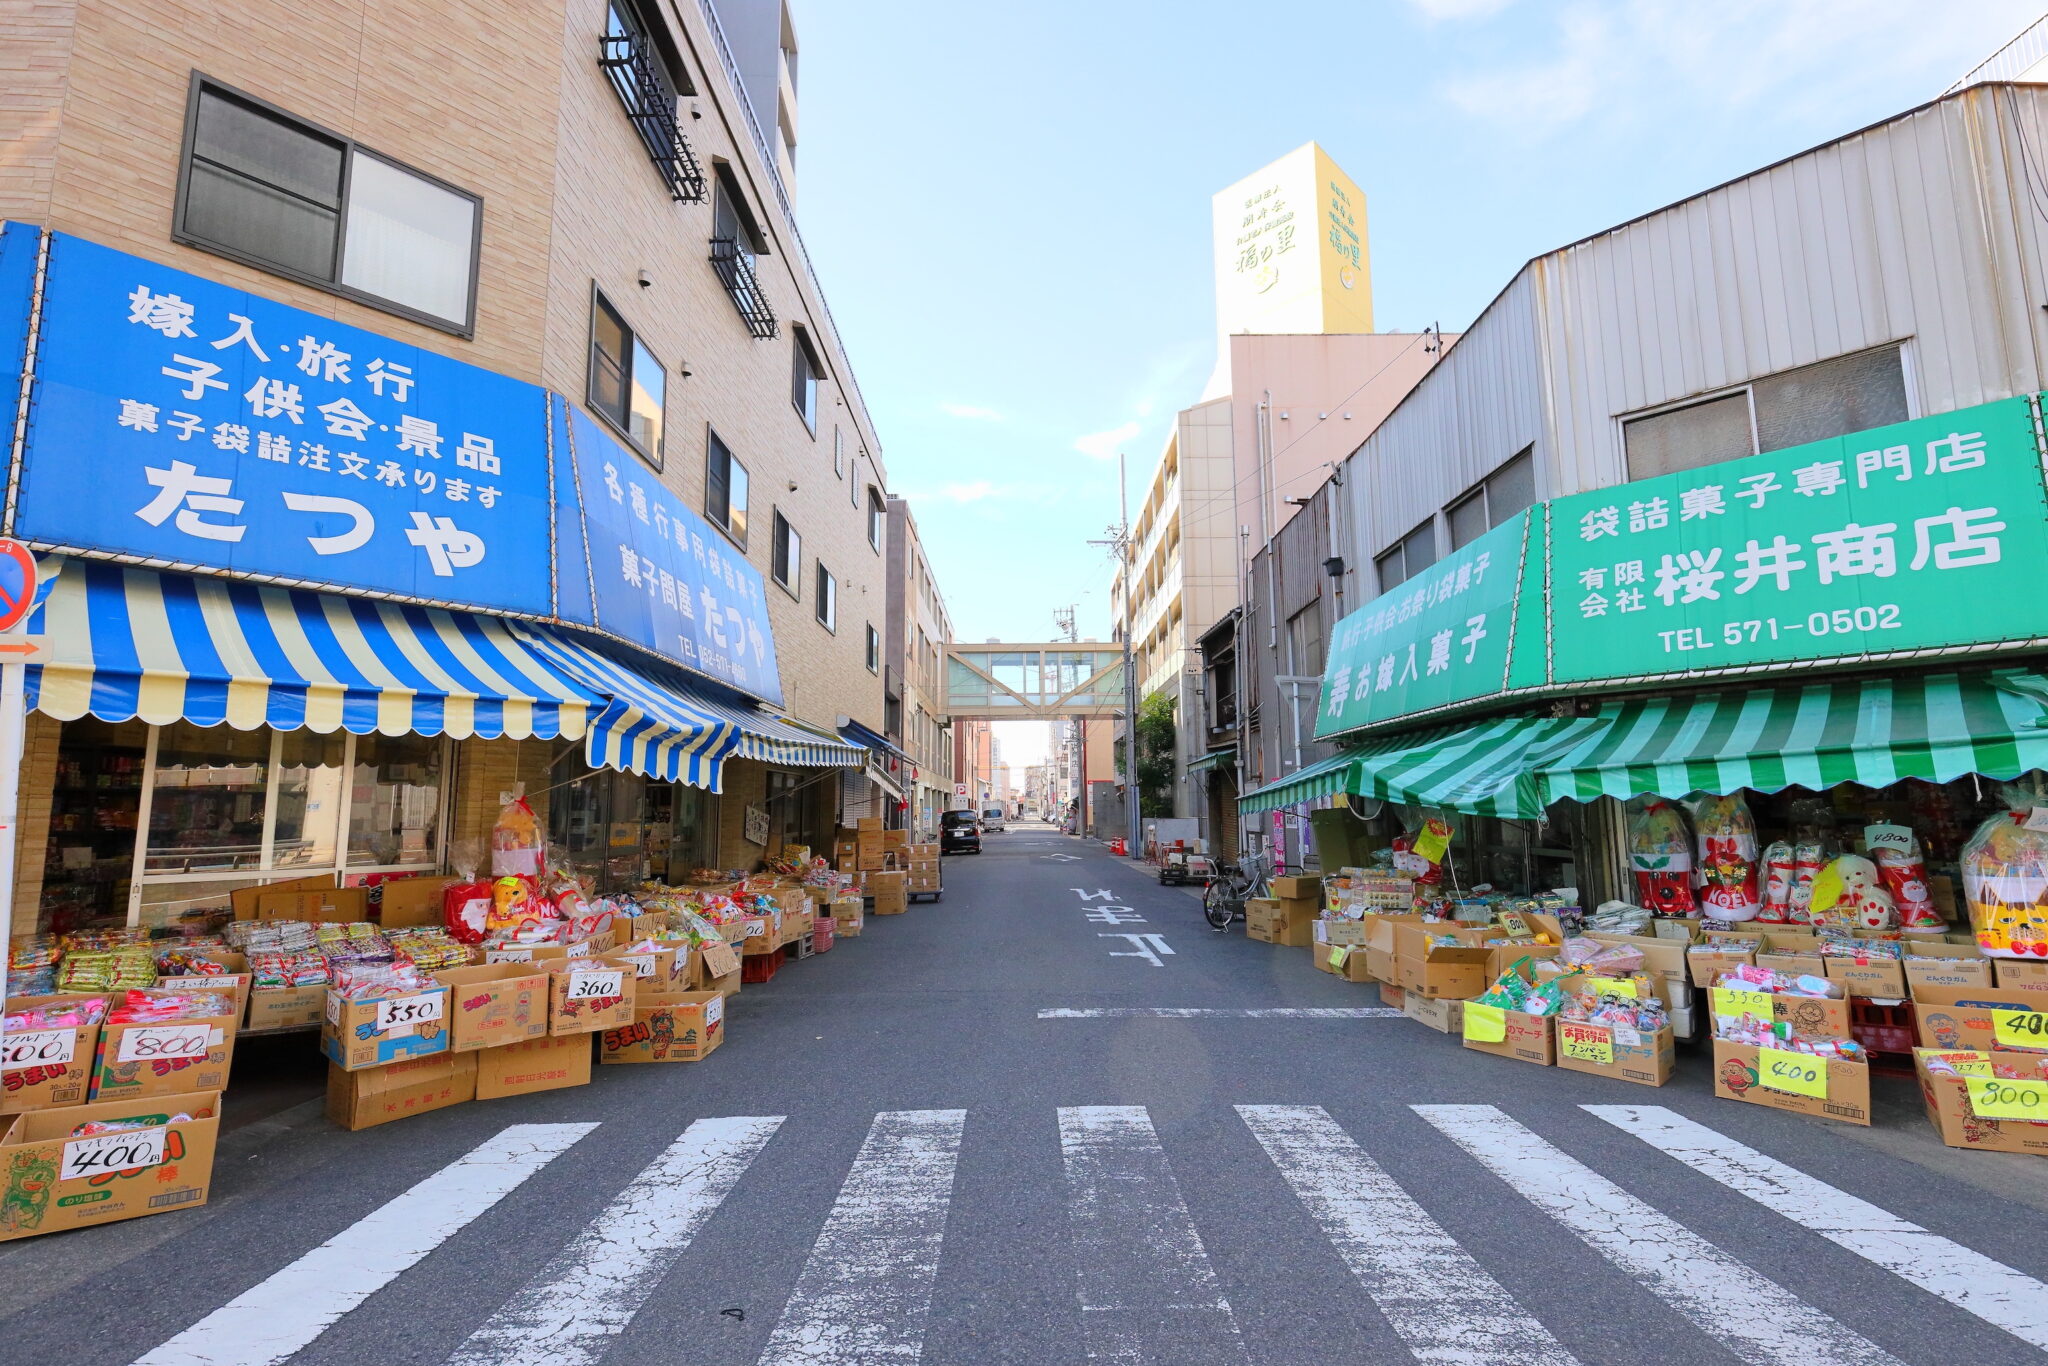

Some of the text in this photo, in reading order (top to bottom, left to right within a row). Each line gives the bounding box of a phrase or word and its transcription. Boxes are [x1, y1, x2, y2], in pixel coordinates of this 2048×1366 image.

[128, 284, 415, 402] 嫁入・旅行
[162, 352, 501, 476] 子供会・景品
[117, 398, 503, 510] 菓子袋詰注文承ります
[1579, 431, 1988, 542] 袋詰菓子専門店
[134, 459, 487, 577] たつや
[1578, 559, 1646, 591] 有限
[1654, 506, 2007, 607] 桜井商店
[619, 543, 765, 668] 菓子問屋 たつや
[1578, 587, 1647, 618] 会社
[677, 634, 698, 658] TEL
[1658, 604, 1902, 653] TEL 571-0502
[1727, 990, 1763, 1004] 550
[1564, 1027, 1608, 1044] お買得品
[2006, 1014, 2048, 1035] 40
[1771, 1061, 1817, 1082] 400
[1981, 1081, 2040, 1108] 800
